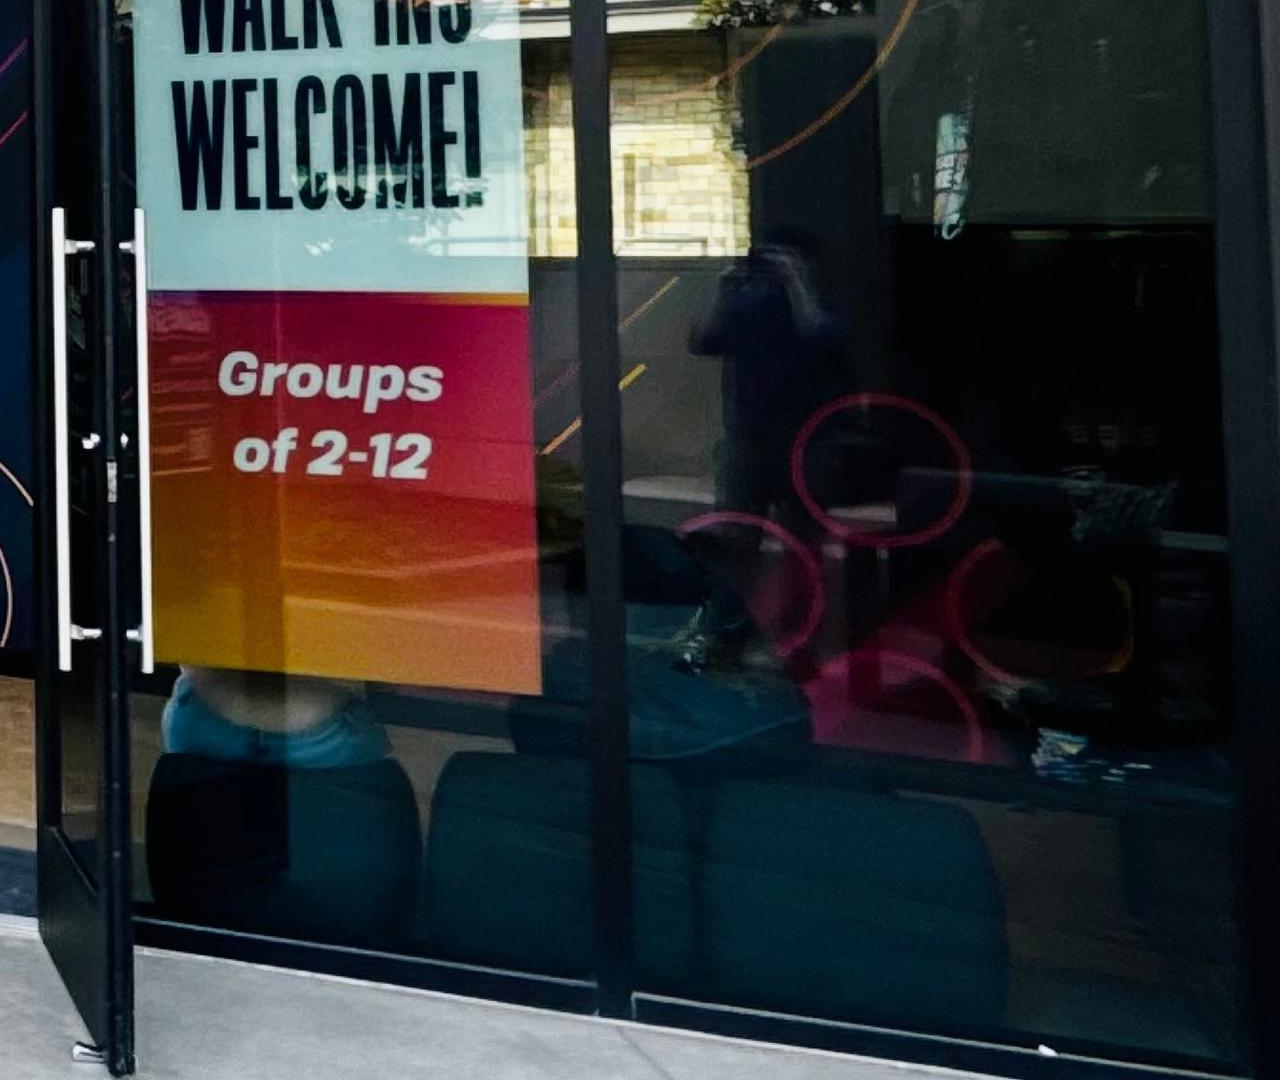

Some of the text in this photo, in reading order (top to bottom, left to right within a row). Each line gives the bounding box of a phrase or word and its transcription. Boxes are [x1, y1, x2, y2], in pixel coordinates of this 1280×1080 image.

[171, 71, 483, 211] WELCOME!
[218, 350, 444, 413] Groups
[233, 427, 433, 480] of 2-12
